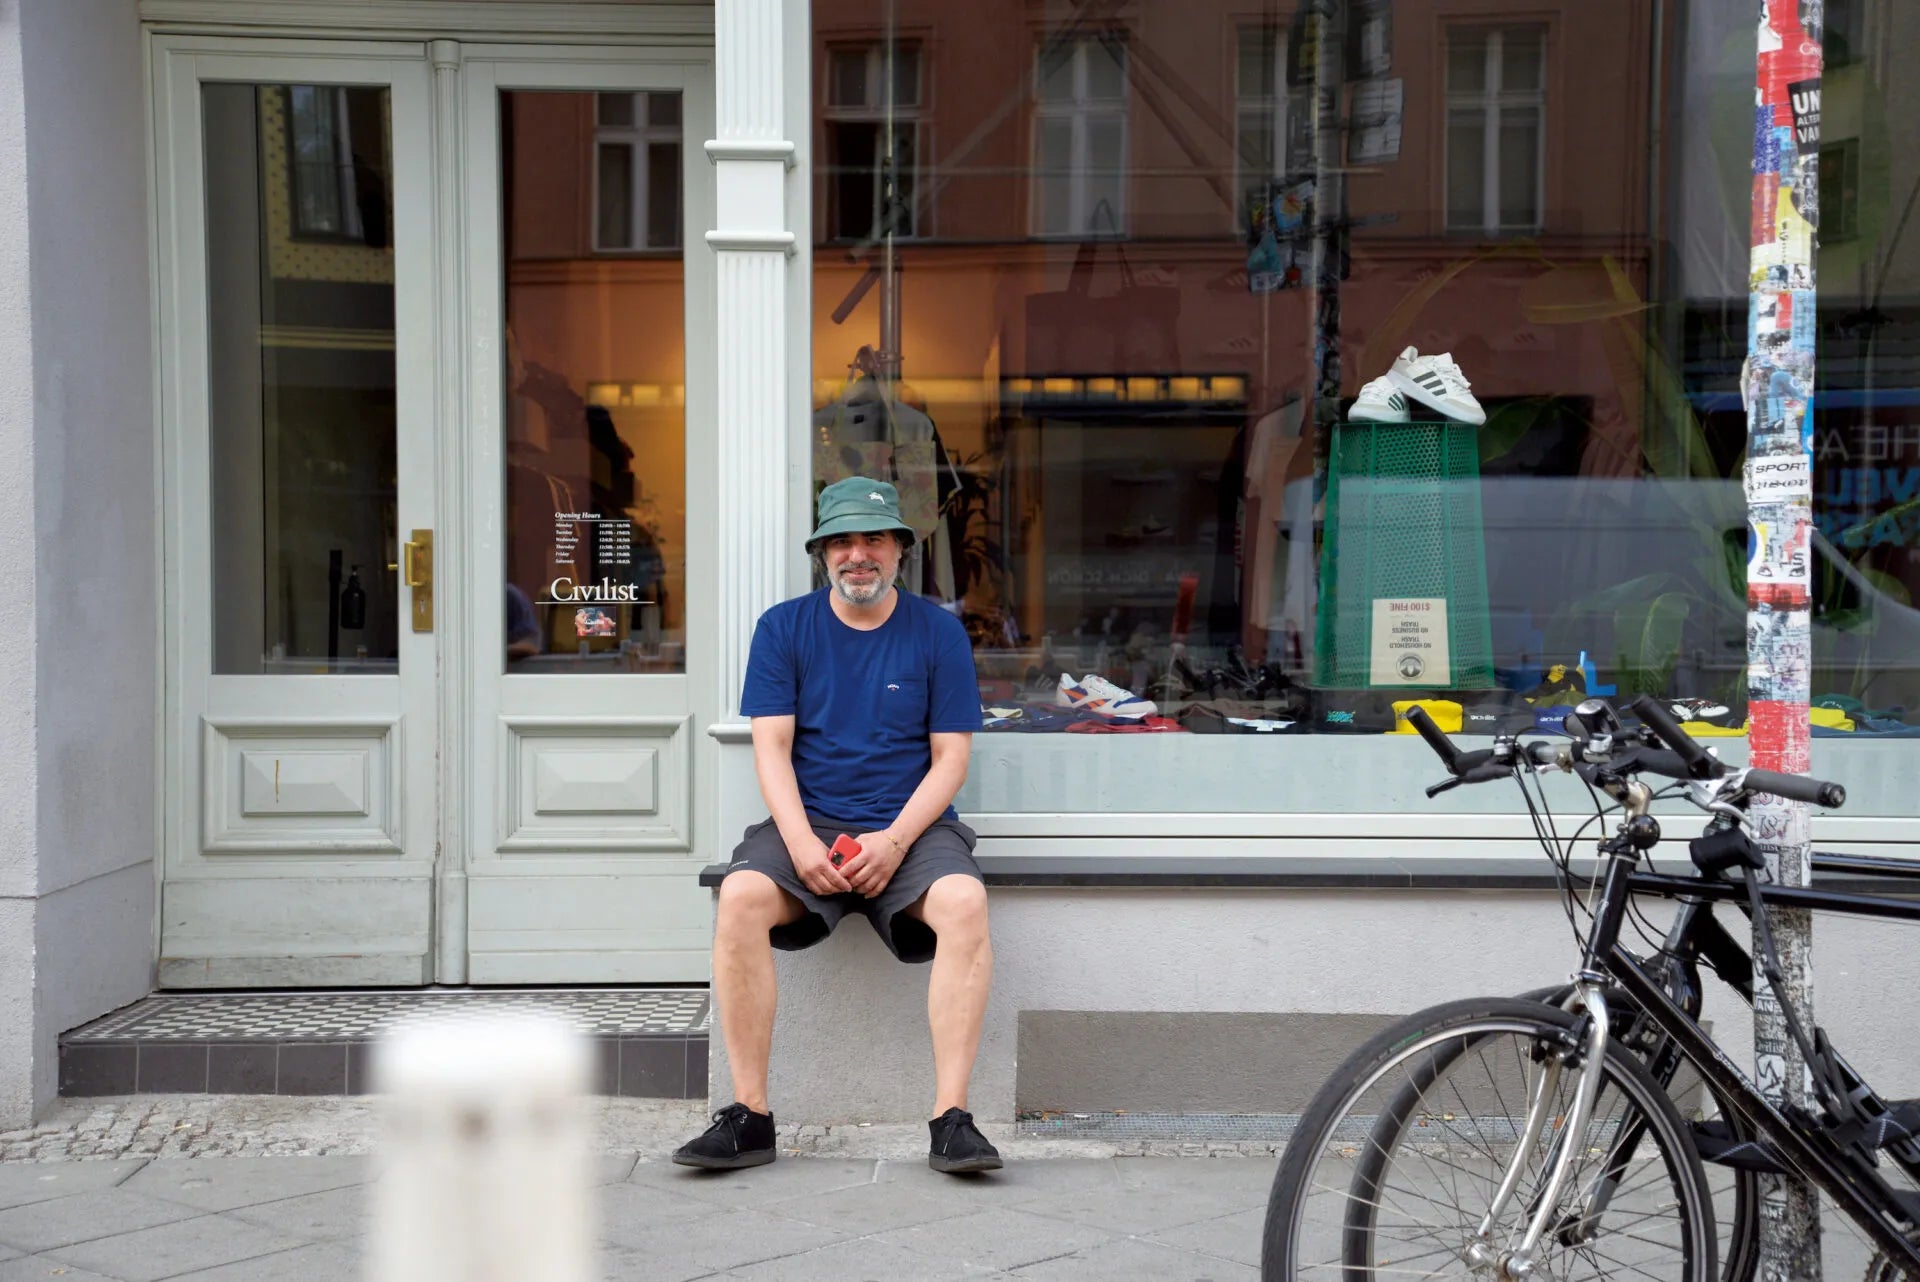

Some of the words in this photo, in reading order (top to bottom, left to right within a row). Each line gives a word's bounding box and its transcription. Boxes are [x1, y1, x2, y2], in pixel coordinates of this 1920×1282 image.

[1755, 462, 1808, 474] SPORT
[551, 577, 638, 601] Civilist
[1390, 602, 1408, 611] FINE
[1410, 602, 1431, 611] $100
